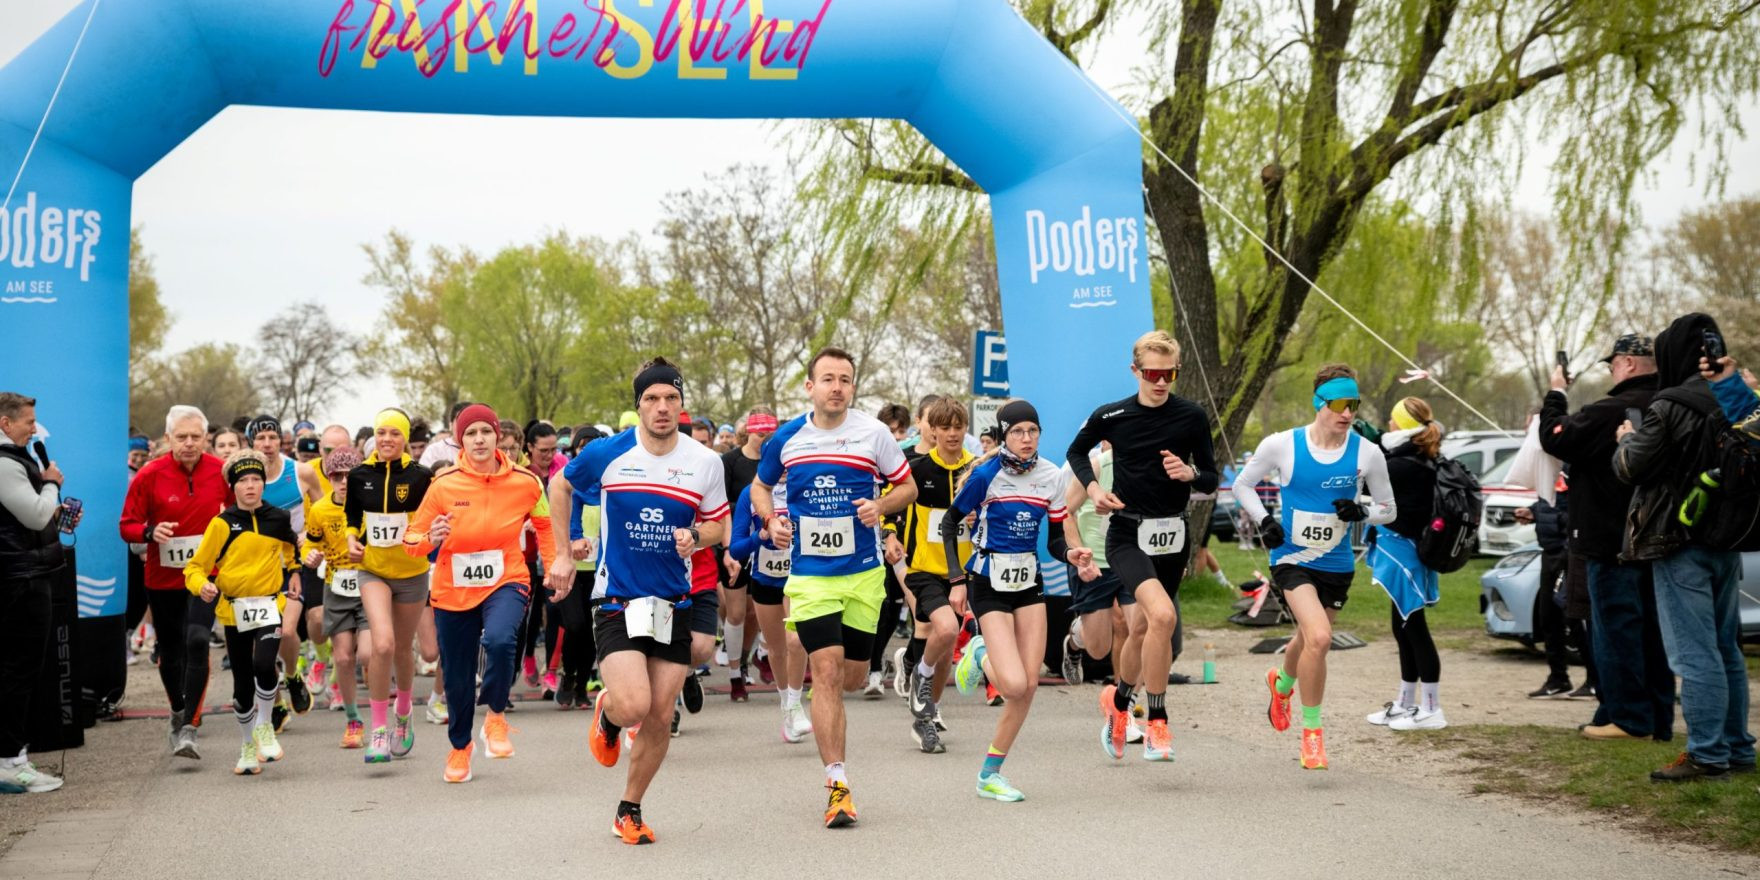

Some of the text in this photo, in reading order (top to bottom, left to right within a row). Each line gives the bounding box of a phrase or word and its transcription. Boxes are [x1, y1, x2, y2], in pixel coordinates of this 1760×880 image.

[601, 0, 799, 80] SEE
[653, 0, 833, 70] Wind
[6, 281, 54, 293] AM SEE
[1073, 286, 1113, 299] AM SEE
[983, 335, 1008, 377] P
[803, 488, 853, 498] GARTNER
[808, 495, 849, 504] SCHIENER
[820, 503, 838, 511] BAU
[372, 526, 399, 540] 517
[629, 531, 672, 541] SCHIENER
[937, 523, 965, 536] 56
[1301, 526, 1333, 541] 459
[810, 532, 843, 548] 240
[1148, 532, 1177, 548] 407
[167, 548, 195, 561] 114
[463, 564, 494, 580] 440
[765, 559, 790, 572] 449
[1000, 567, 1029, 583] 476
[341, 579, 358, 591] 45
[242, 608, 269, 623] 472
